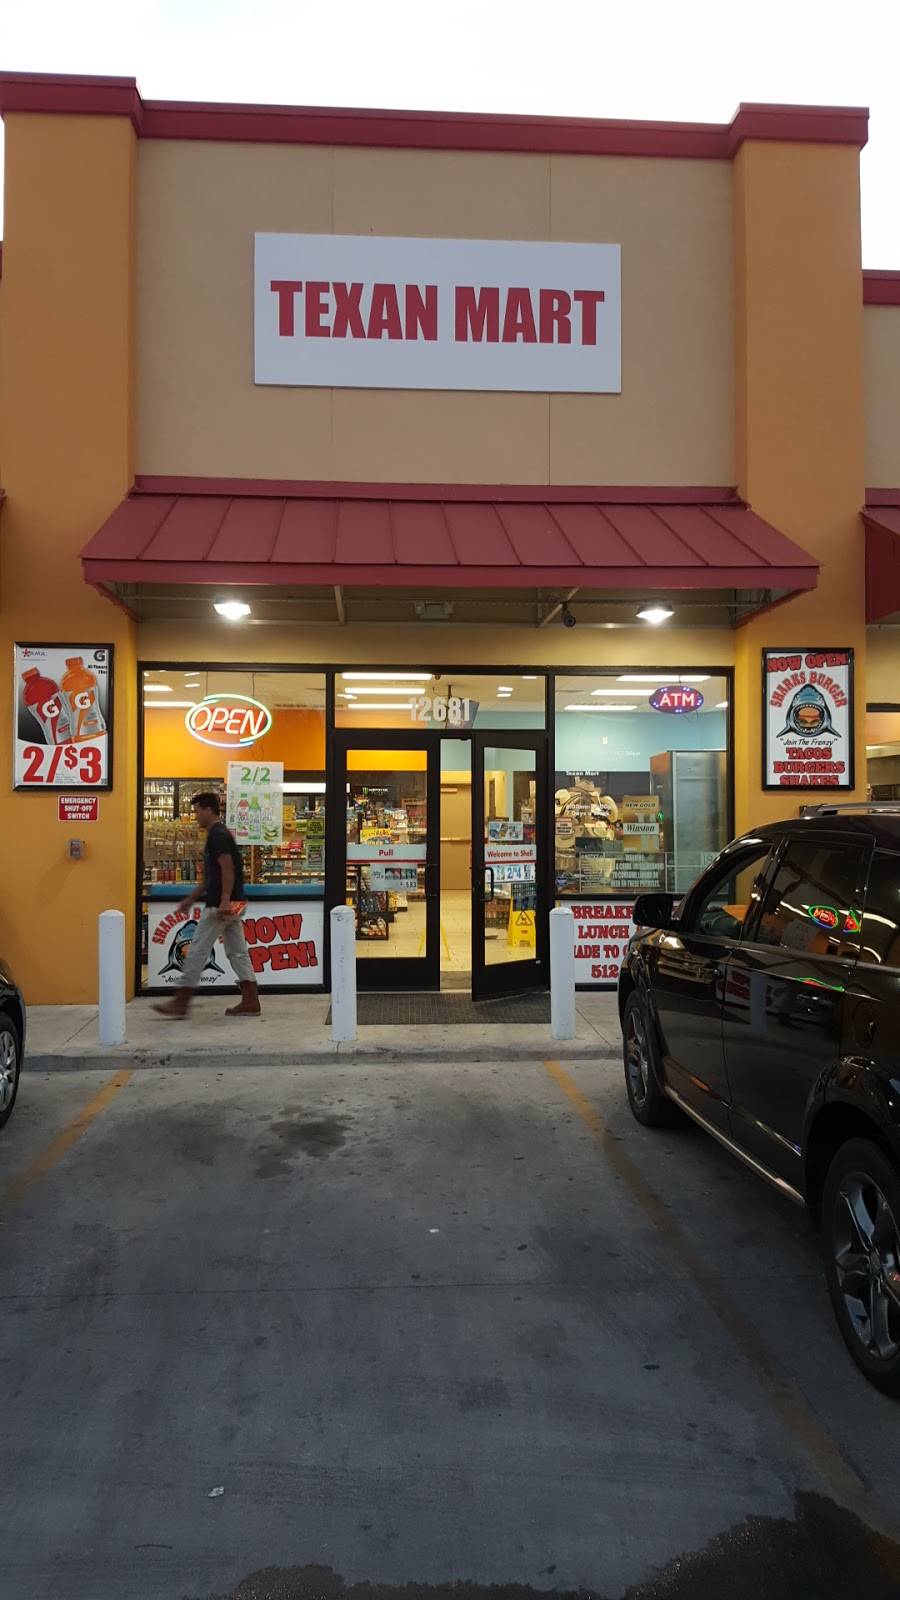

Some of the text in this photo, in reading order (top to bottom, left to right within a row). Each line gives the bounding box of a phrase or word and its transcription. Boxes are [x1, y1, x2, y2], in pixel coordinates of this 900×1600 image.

[270, 280, 605, 346] TEXAN MART
[767, 656, 802, 672] NOW
[769, 671, 848, 708] SHARKS BURGER
[659, 693, 695, 707] ATM
[408, 696, 470, 722] 12681
[190, 706, 265, 735] OPEN
[799, 738, 810, 746] The
[786, 747, 832, 760] TACOS
[773, 761, 845, 773] BURGERS
[779, 775, 839, 785] SHAKES
[66, 812, 91, 820] SWITCH
[626, 824, 655, 833] Winston
[487, 850, 512, 858] Welcome
[571, 905, 633, 919] BREAKF
[578, 925, 630, 939] LUNCH
[248, 941, 318, 972] PEN!
[604, 945, 619, 958] TO
